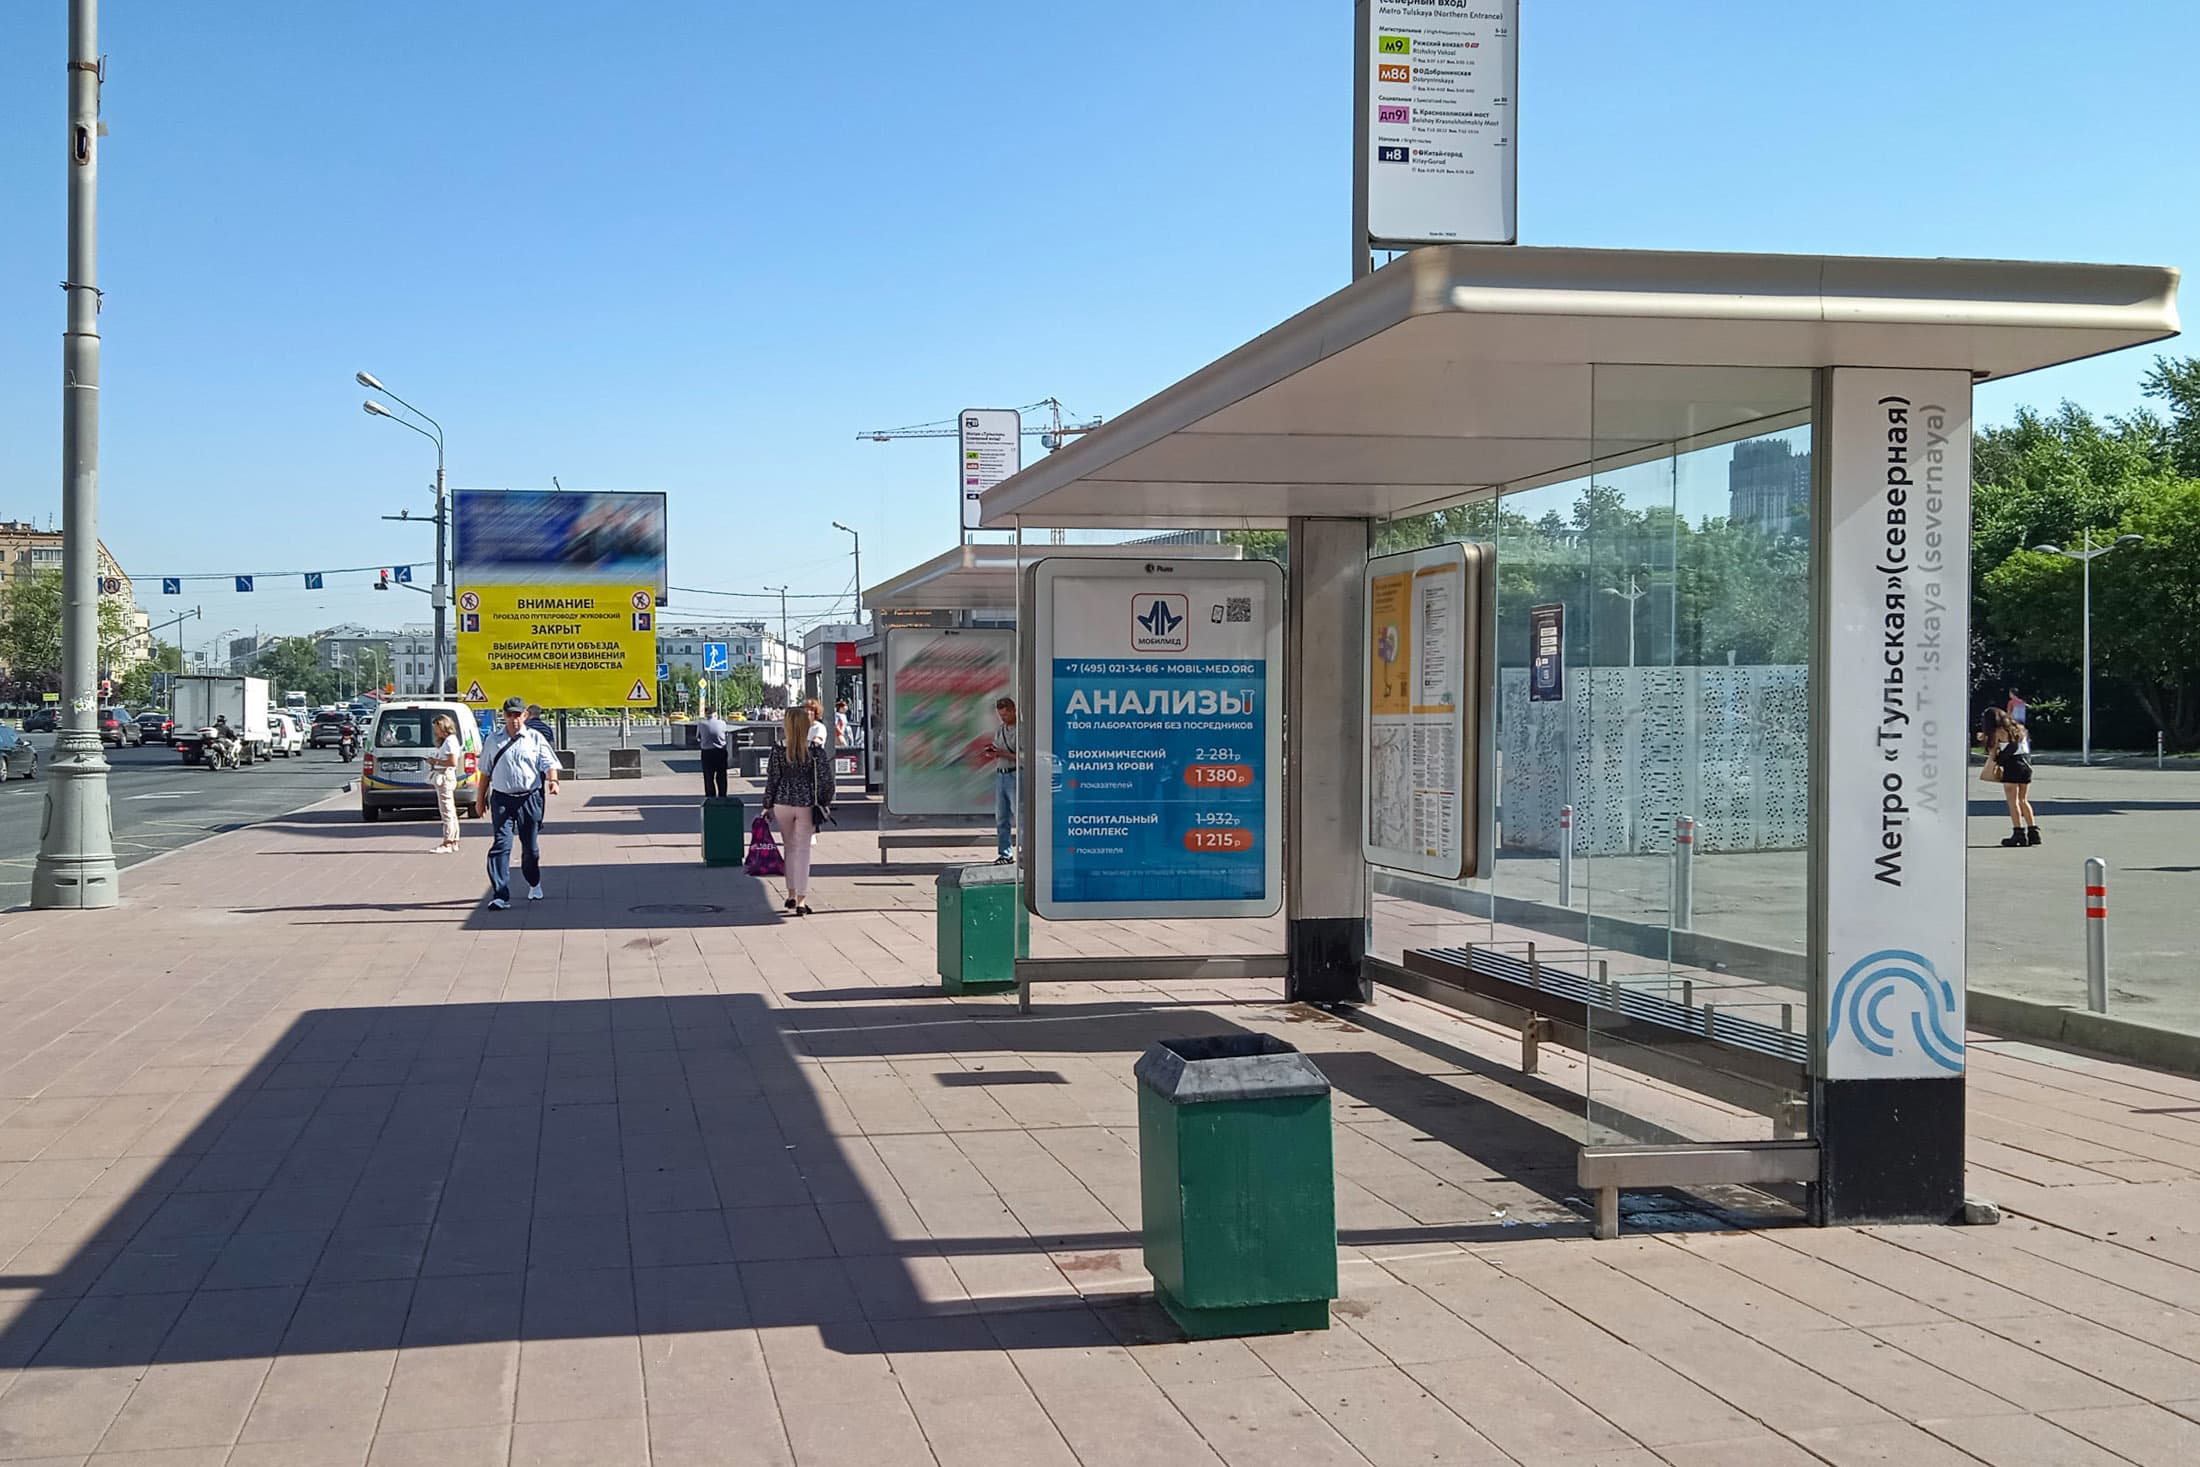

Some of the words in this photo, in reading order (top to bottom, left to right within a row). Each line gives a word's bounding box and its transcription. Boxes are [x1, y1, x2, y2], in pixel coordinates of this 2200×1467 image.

[1378, 7, 1402, 15] Metro
[1403, 8, 1433, 17] Tulskaya
[1434, 10, 1468, 19] (Northern
[1470, 12, 1504, 20] Entrance)
[1385, 40, 1403, 52] м9
[1380, 69, 1408, 80] м86
[1380, 110, 1407, 121] дп91
[1386, 149, 1402, 161] н8
[1918, 403, 1948, 573] (severnaya)
[518, 598, 594, 609] ВНИМАНИЕ!
[531, 624, 581, 635] ЗАКРЫТ
[493, 641, 549, 650] ВЫБИРАЙТЕ
[550, 642, 575, 650] ПУТИ
[577, 642, 620, 650] ОБЪЕЗДА
[1138, 638, 1182, 646] МОБИЛМЕД
[1916, 577, 1946, 711] Tlskaya
[488, 652, 542, 660] ПРИНОСИМ
[543, 652, 569, 660] СВОИ
[570, 652, 626, 660] ИЗВИНЕНИЯ
[490, 662, 502, 670] ЗА
[504, 662, 562, 670] ВРЕМЕННЫЕ
[564, 662, 623, 671] НЕУДОБСТВА
[1066, 664, 1078, 673] +7
[1080, 664, 1106, 674] (495)
[1108, 664, 1159, 673] 021-34-86
[1167, 664, 1255, 673] MOBIL-MED.ORG
[1067, 722, 1092, 730] ТВОЯ
[1093, 722, 1162, 730] ЛАБОРАТОРИЯ
[1164, 722, 1182, 730] БЕЗ
[1183, 722, 1254, 730] ПОСРЕДНИКОВ
[1068, 749, 1166, 759] БИОХИМИЧЕСКИЙ
[1068, 762, 1114, 771] АНАЛИЗ
[1116, 762, 1154, 770] КРОВИ
[1916, 720, 1939, 814] Metro
[1080, 782, 1133, 790] показателей
[1068, 814, 1158, 824] ГОСПИТАЛЬНЫЙ
[1068, 827, 1129, 836] КОМПЛЕКС
[1875, 773, 1909, 888] Метро
